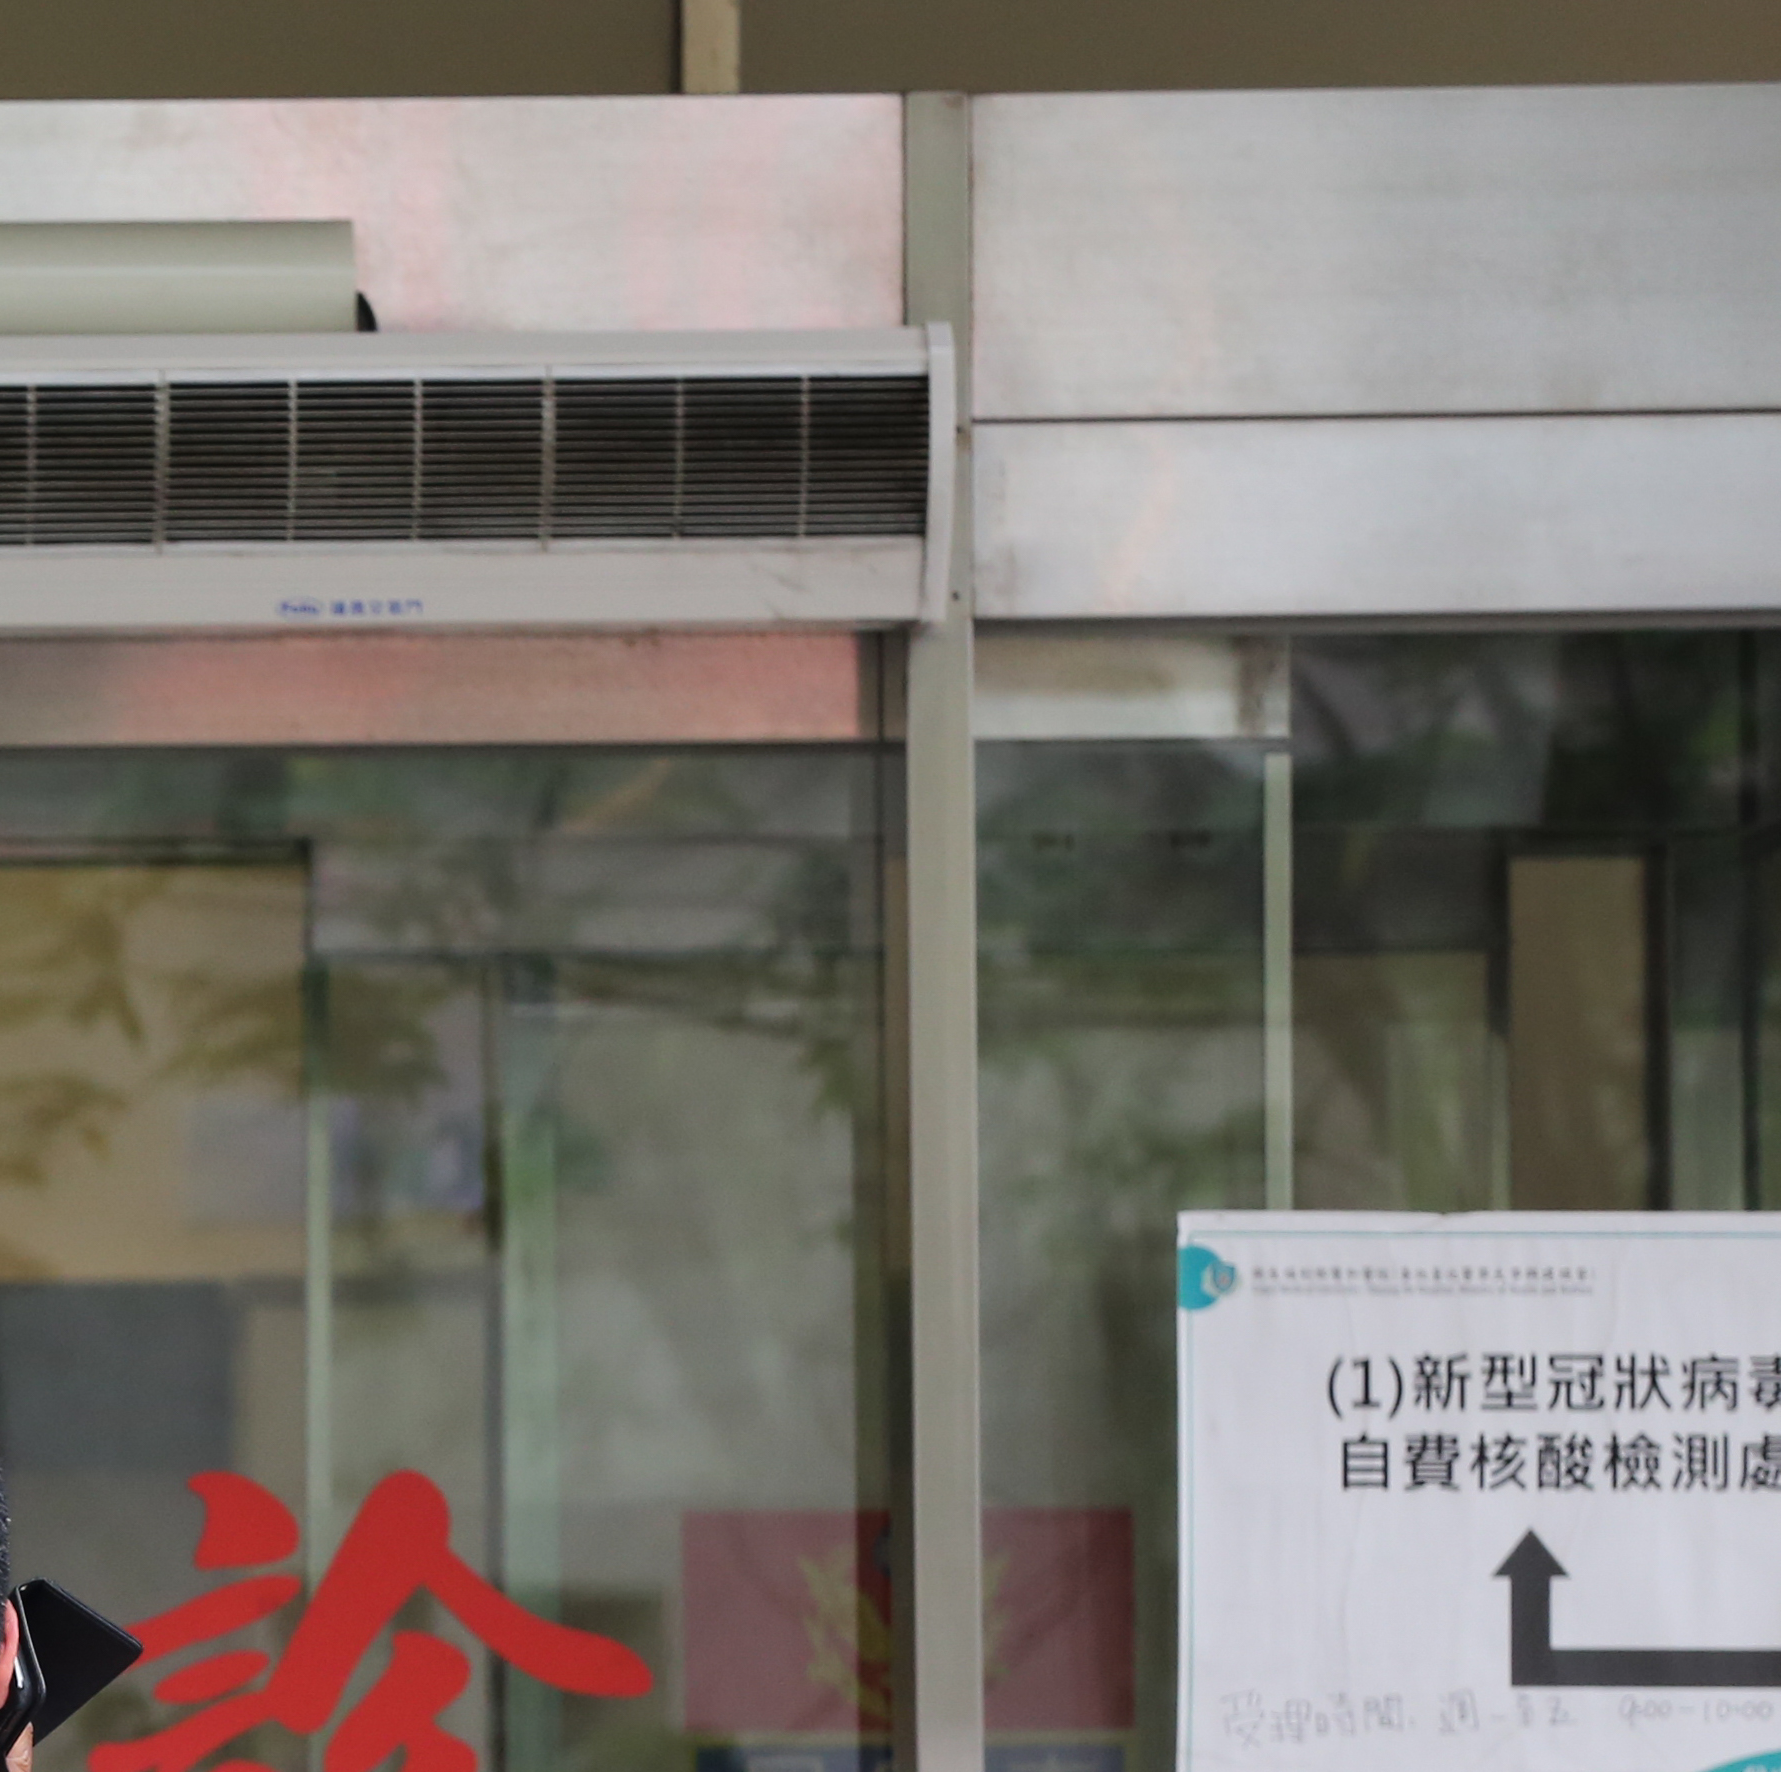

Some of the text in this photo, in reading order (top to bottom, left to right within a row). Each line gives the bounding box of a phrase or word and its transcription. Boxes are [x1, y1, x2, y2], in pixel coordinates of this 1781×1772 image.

[1341, 1432, 1781, 1491] 自費核酸檢測處
